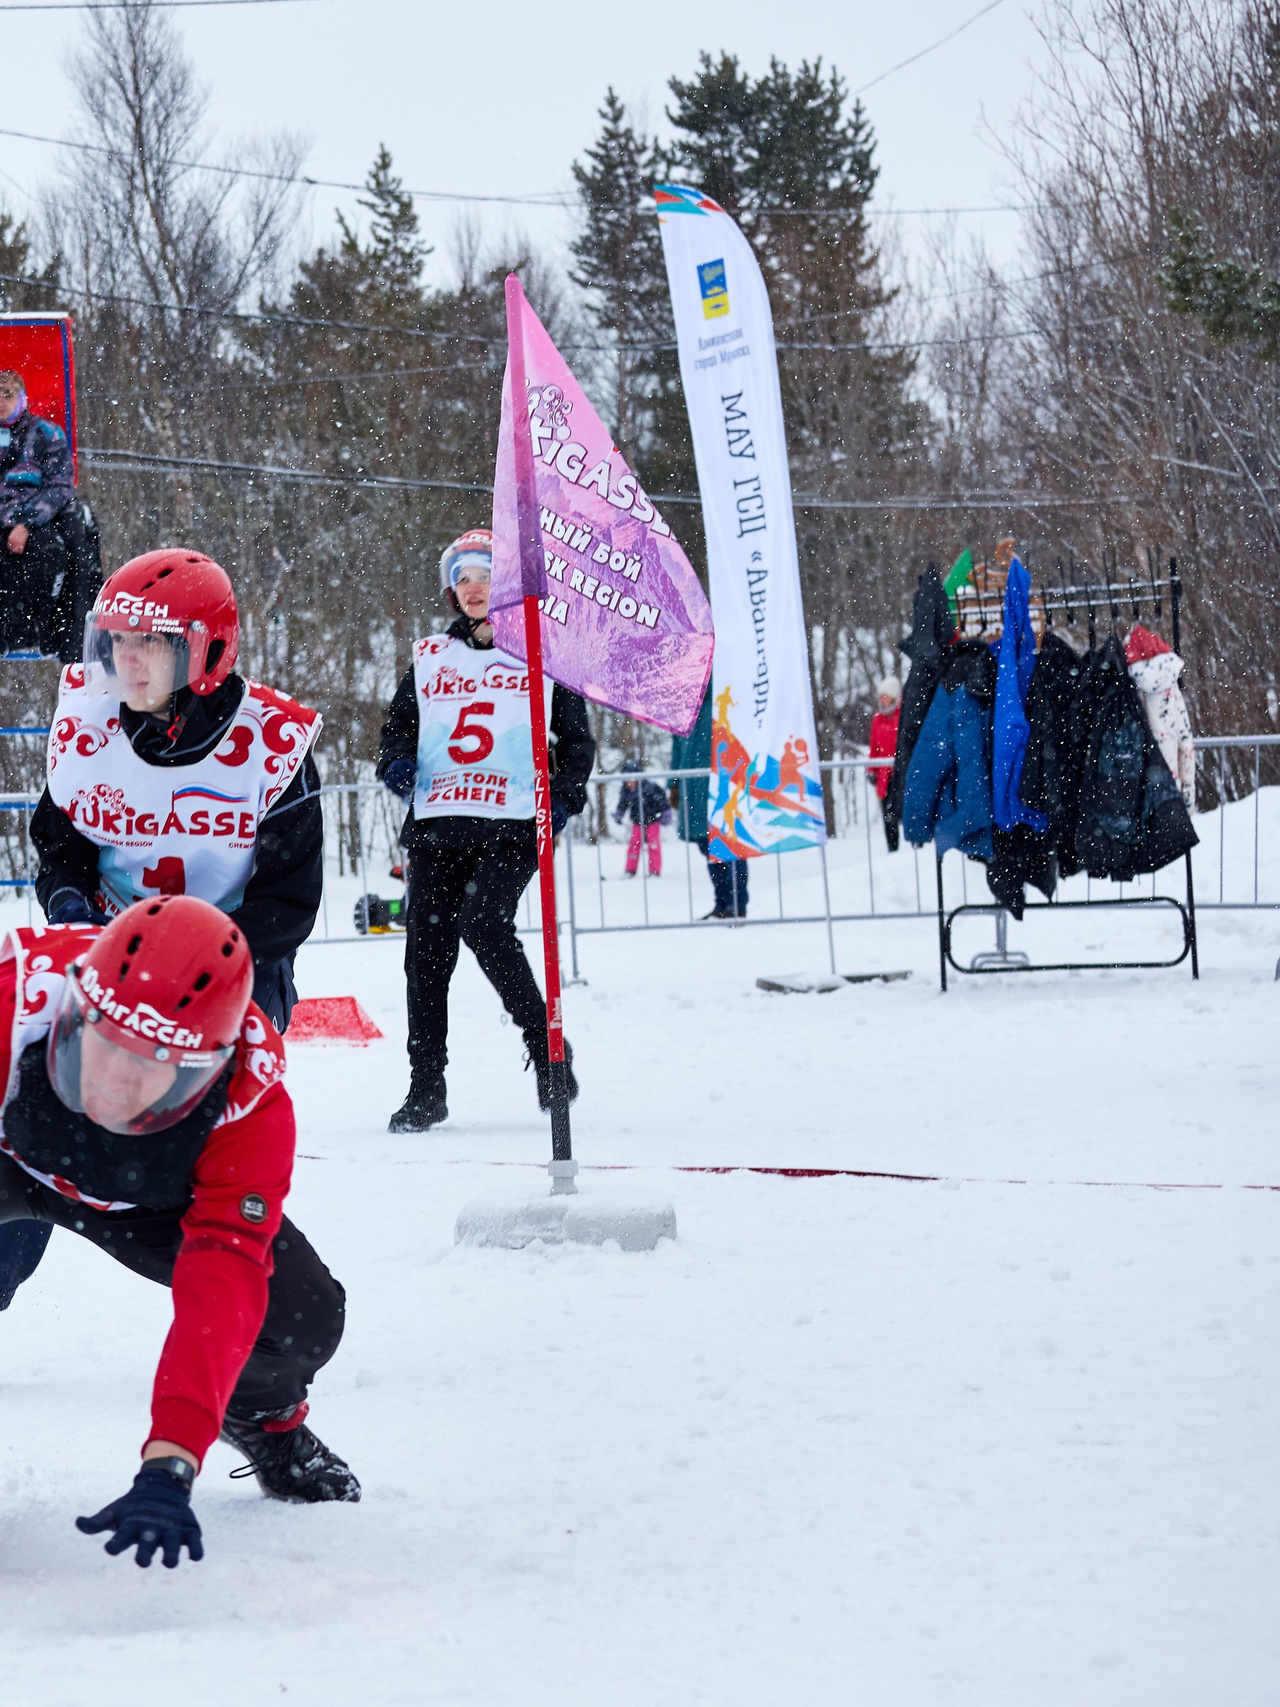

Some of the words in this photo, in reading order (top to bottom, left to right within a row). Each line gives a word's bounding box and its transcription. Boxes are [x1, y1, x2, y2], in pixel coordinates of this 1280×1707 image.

[720, 388, 756, 462] МАУ
[529, 412, 678, 541] KIGASS
[733, 474, 767, 539] ГСЦ
[539, 503, 594, 555] НЫЙ
[590, 540, 643, 583] БОЙ
[538, 593, 570, 626] IA
[544, 550, 569, 583] SK
[569, 566, 661, 629] REGION
[421, 672, 530, 699] YUKIGASSE
[447, 701, 496, 765] 5
[441, 786, 507, 806] СНЕГЕ
[462, 772, 509, 788] ТОЛК
[59, 794, 256, 841] YUKIGASSE
[125, 840, 153, 848] REGION
[534, 776, 548, 856] LISKI
[79, 965, 204, 1049] ЮКИГАССЕН
